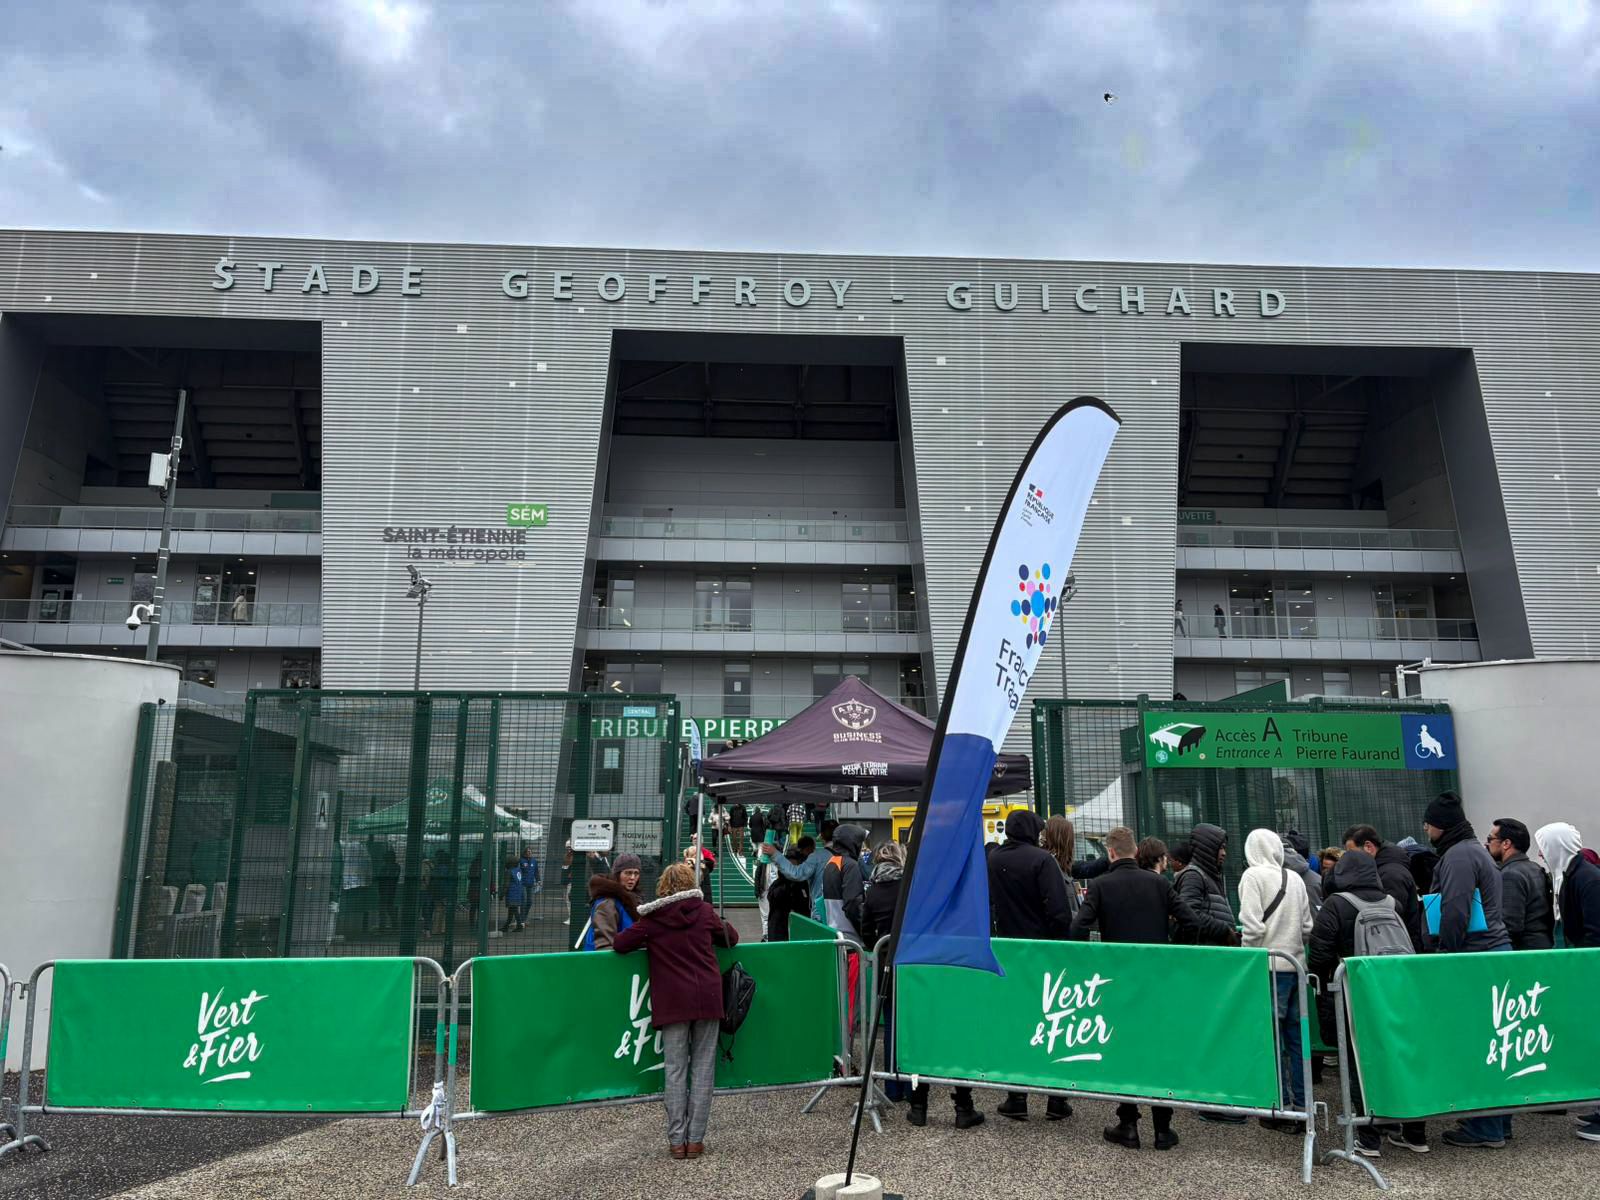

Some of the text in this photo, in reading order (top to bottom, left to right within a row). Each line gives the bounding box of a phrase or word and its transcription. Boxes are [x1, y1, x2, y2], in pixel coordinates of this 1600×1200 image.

[212, 261, 423, 296] STADE
[502, 269, 852, 309] GEOFFROY
[946, 281, 1287, 317] GUICHARD
[510, 505, 545, 521] SÉM
[383, 525, 527, 545] SAINT-ÉTIENNE
[407, 544, 525, 564] la métropole
[704, 719, 788, 737] PIERR
[833, 732, 881, 740] BUSINESS
[1215, 717, 1282, 743] Accès A
[1292, 729, 1348, 743] Tribune
[1216, 747, 1283, 759] Entrance A
[1296, 746, 1400, 761] Pierre Faurand
[319, 797, 326, 822] A
[1042, 968, 1113, 1014] Vert
[198, 986, 269, 1034] Vert
[1491, 979, 1551, 1030] Vert
